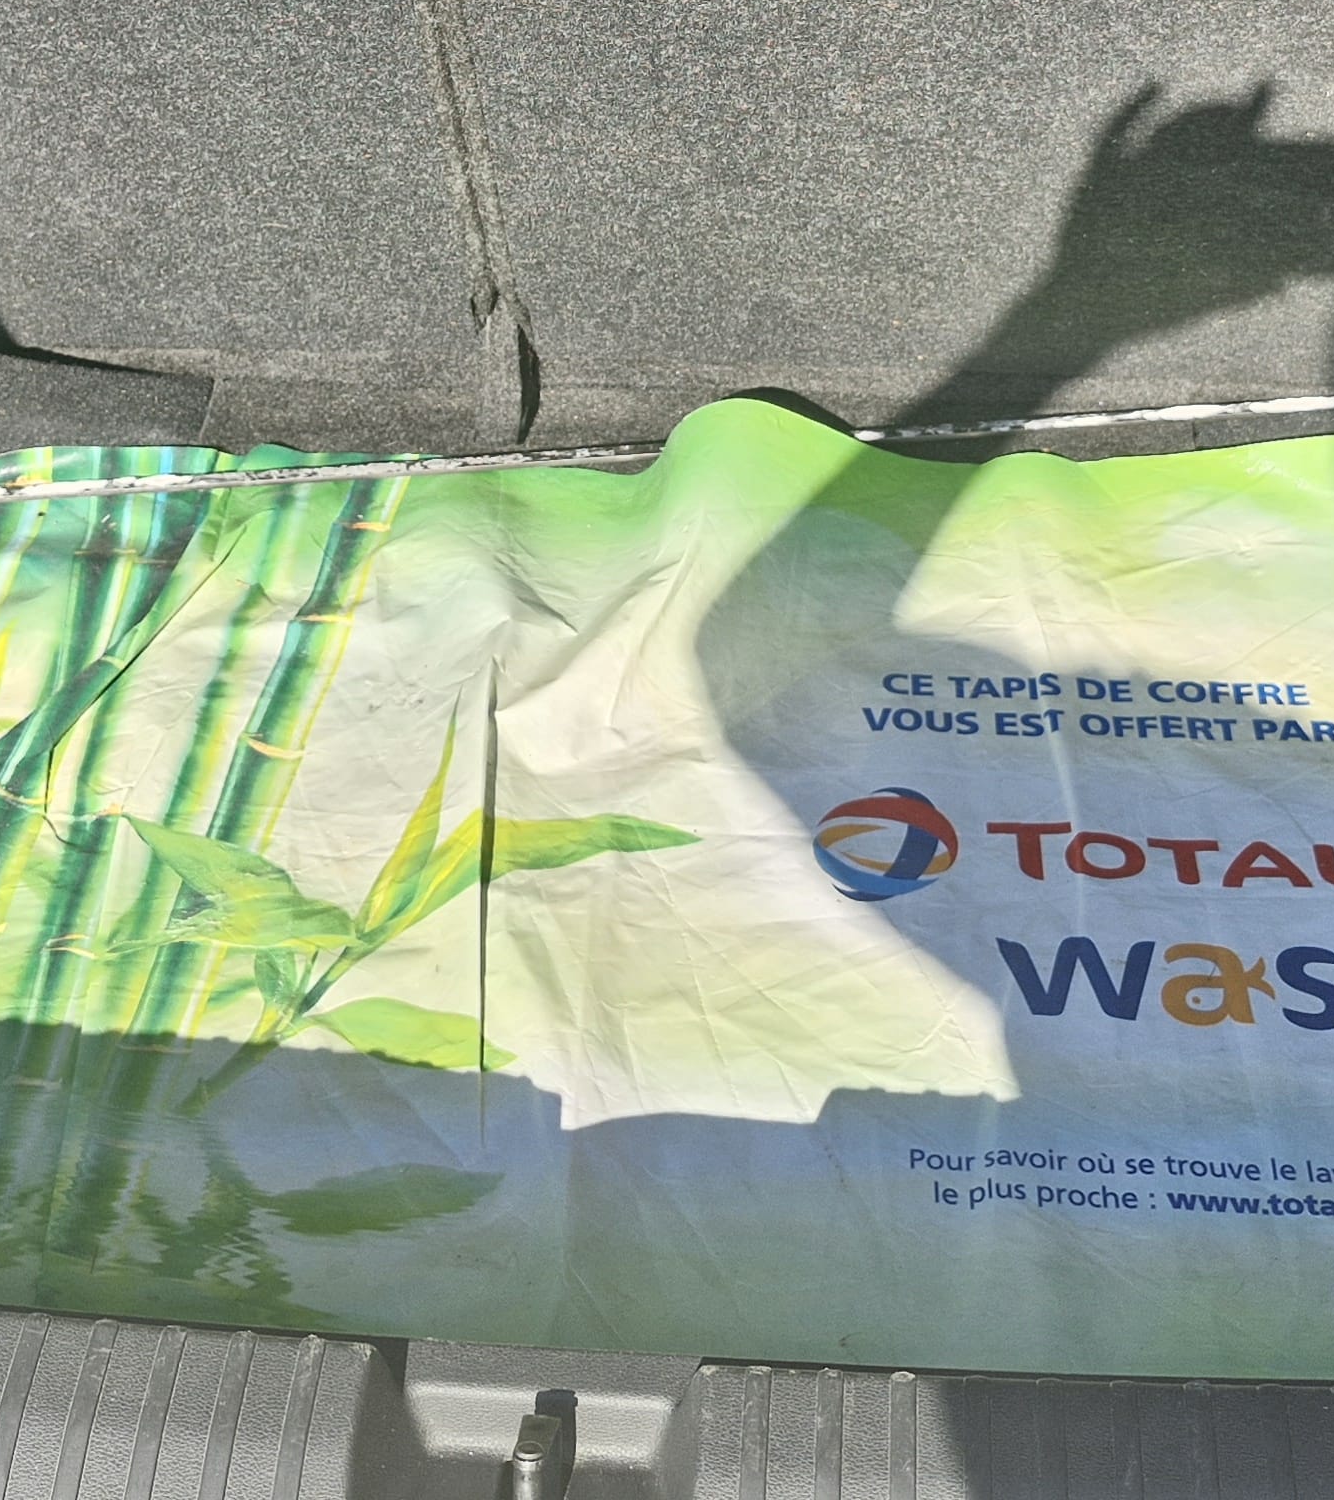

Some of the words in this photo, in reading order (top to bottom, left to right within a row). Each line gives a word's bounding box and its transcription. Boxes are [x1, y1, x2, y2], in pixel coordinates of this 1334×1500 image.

[882, 673, 935, 696] CE
[948, 673, 1062, 698] TAPIS
[1077, 677, 1133, 702] DE
[1148, 680, 1310, 705] COFFRE
[863, 708, 979, 736] VOUS
[995, 710, 1064, 737] EST
[1079, 713, 1237, 741] OFFERT
[909, 1148, 975, 1171] Pour
[984, 1148, 1066, 1171] savoir
[1078, 1151, 1115, 1174] où
[1125, 1158, 1155, 1175] se
[1164, 1155, 1261, 1180] trouve
[1271, 1158, 1297, 1181] le
[934, 1181, 959, 1205] le
[969, 1178, 1027, 1210] plus
[1037, 1183, 1139, 1213] proche
